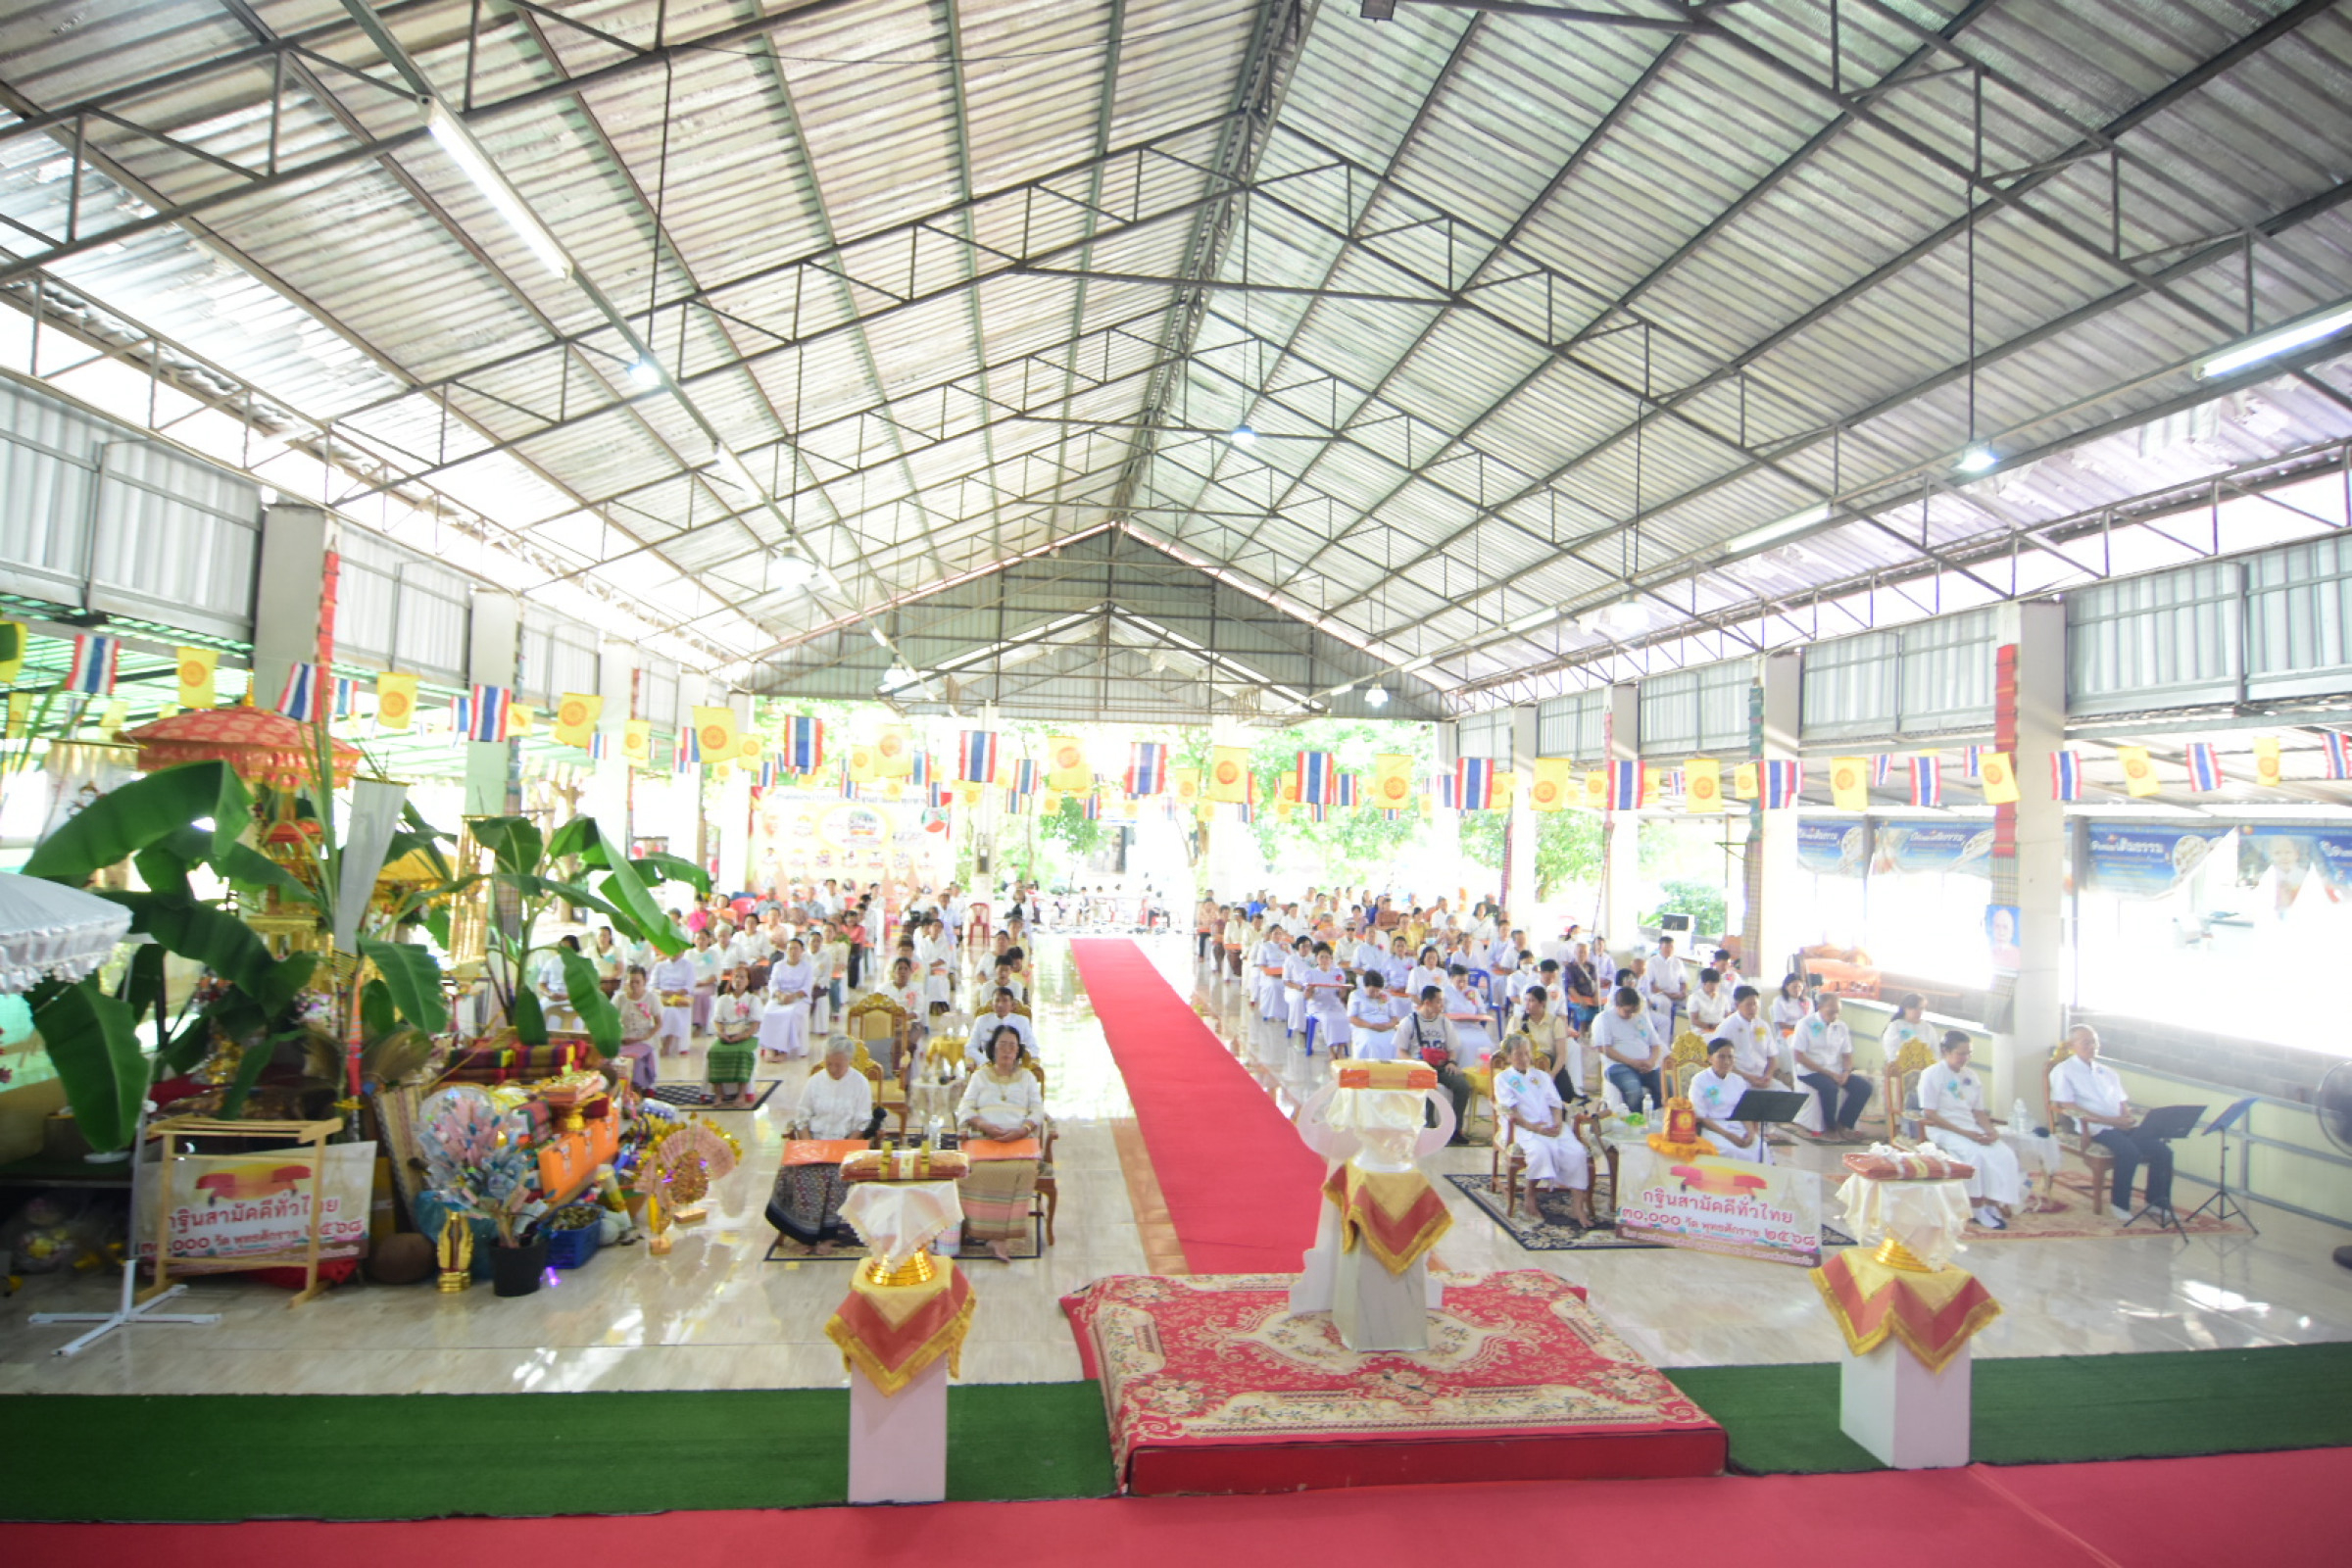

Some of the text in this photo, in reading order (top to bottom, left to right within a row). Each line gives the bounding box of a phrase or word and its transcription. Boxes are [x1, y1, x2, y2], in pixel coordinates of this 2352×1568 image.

[169, 1192, 339, 1234] ฐินสามัคคีทั่วไย
